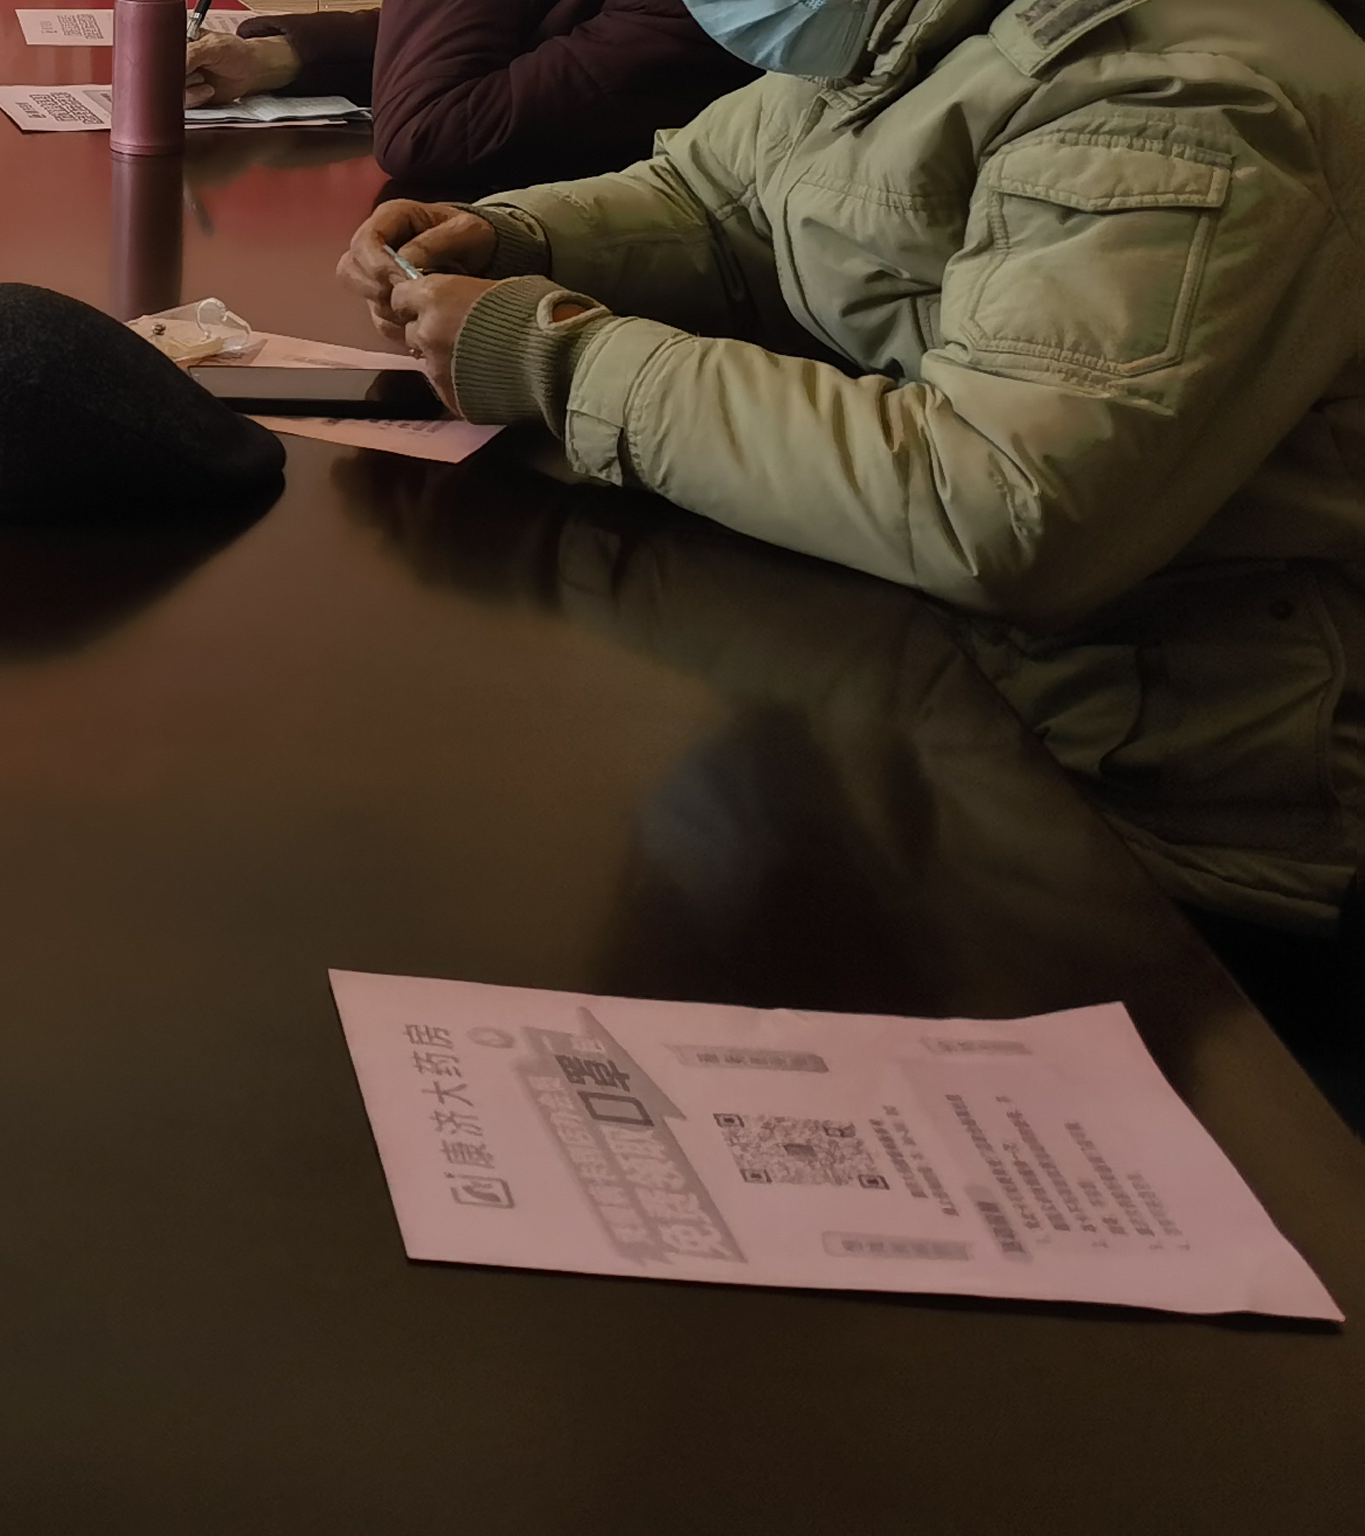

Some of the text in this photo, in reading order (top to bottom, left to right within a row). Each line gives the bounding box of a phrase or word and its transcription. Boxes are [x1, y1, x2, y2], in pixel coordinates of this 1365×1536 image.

[403, 1024, 496, 1170] 康济大药房
